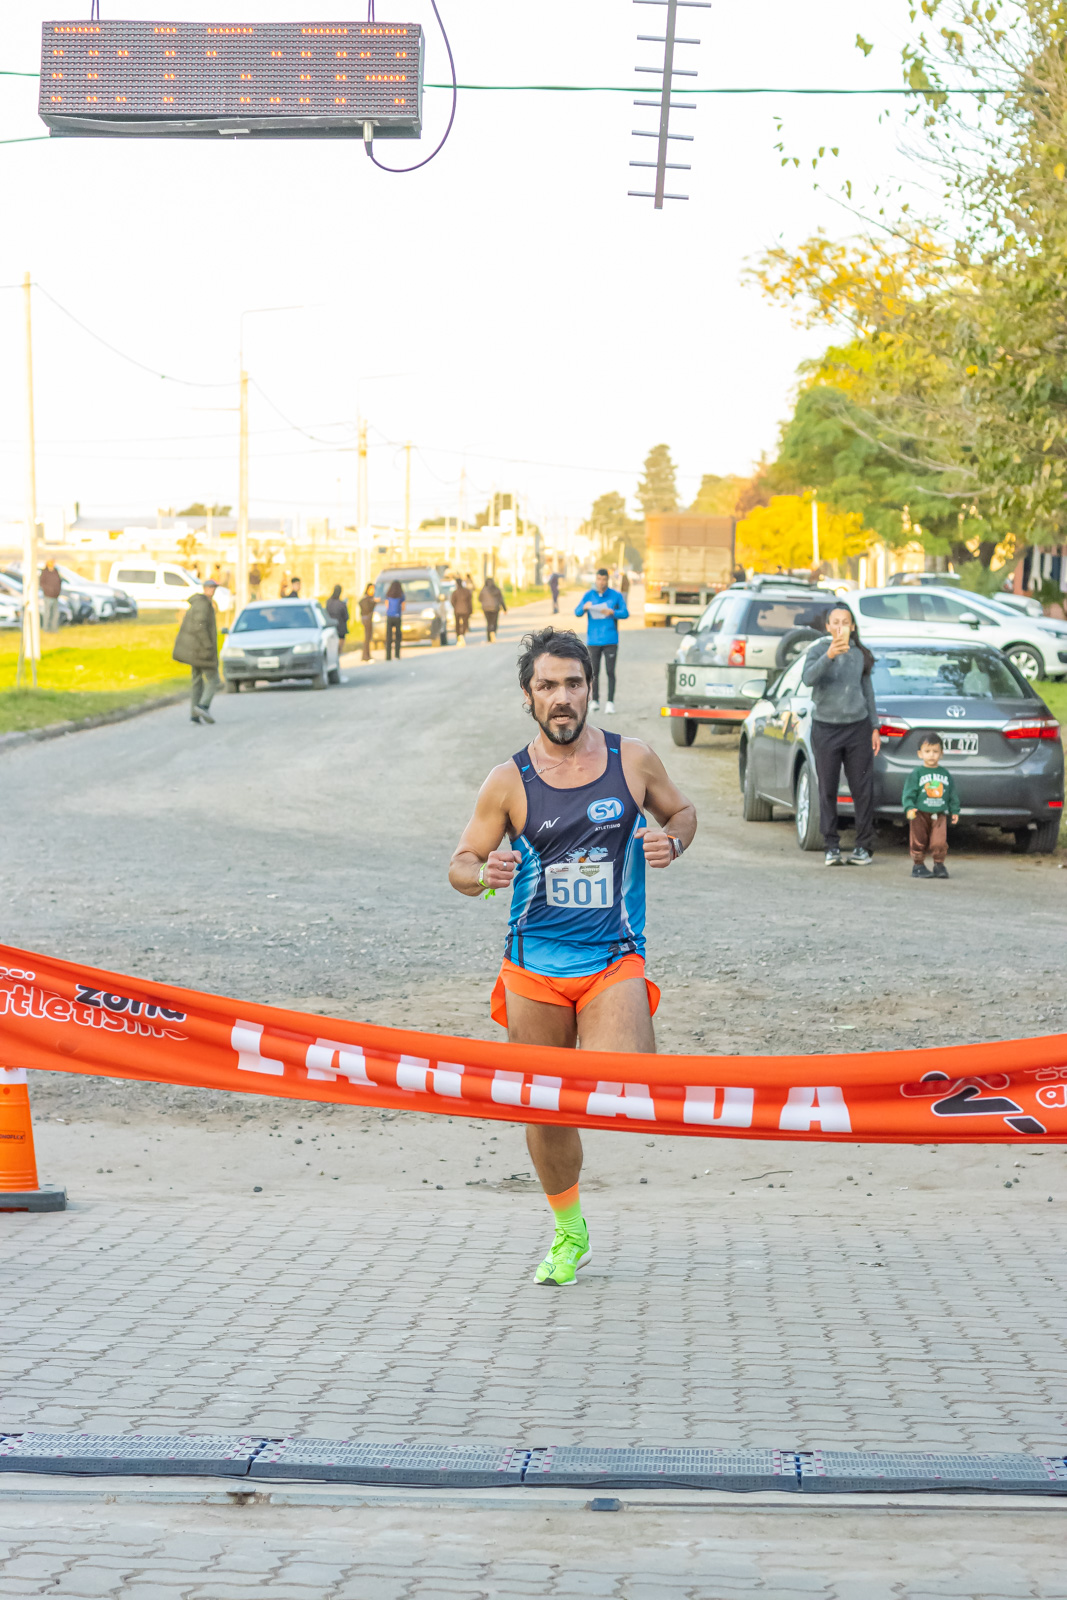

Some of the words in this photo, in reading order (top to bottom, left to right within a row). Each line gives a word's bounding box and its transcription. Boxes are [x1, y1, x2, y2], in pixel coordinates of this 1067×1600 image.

[678, 673, 696, 687] 80
[957, 738, 977, 751] 477
[552, 878, 608, 906] 501
